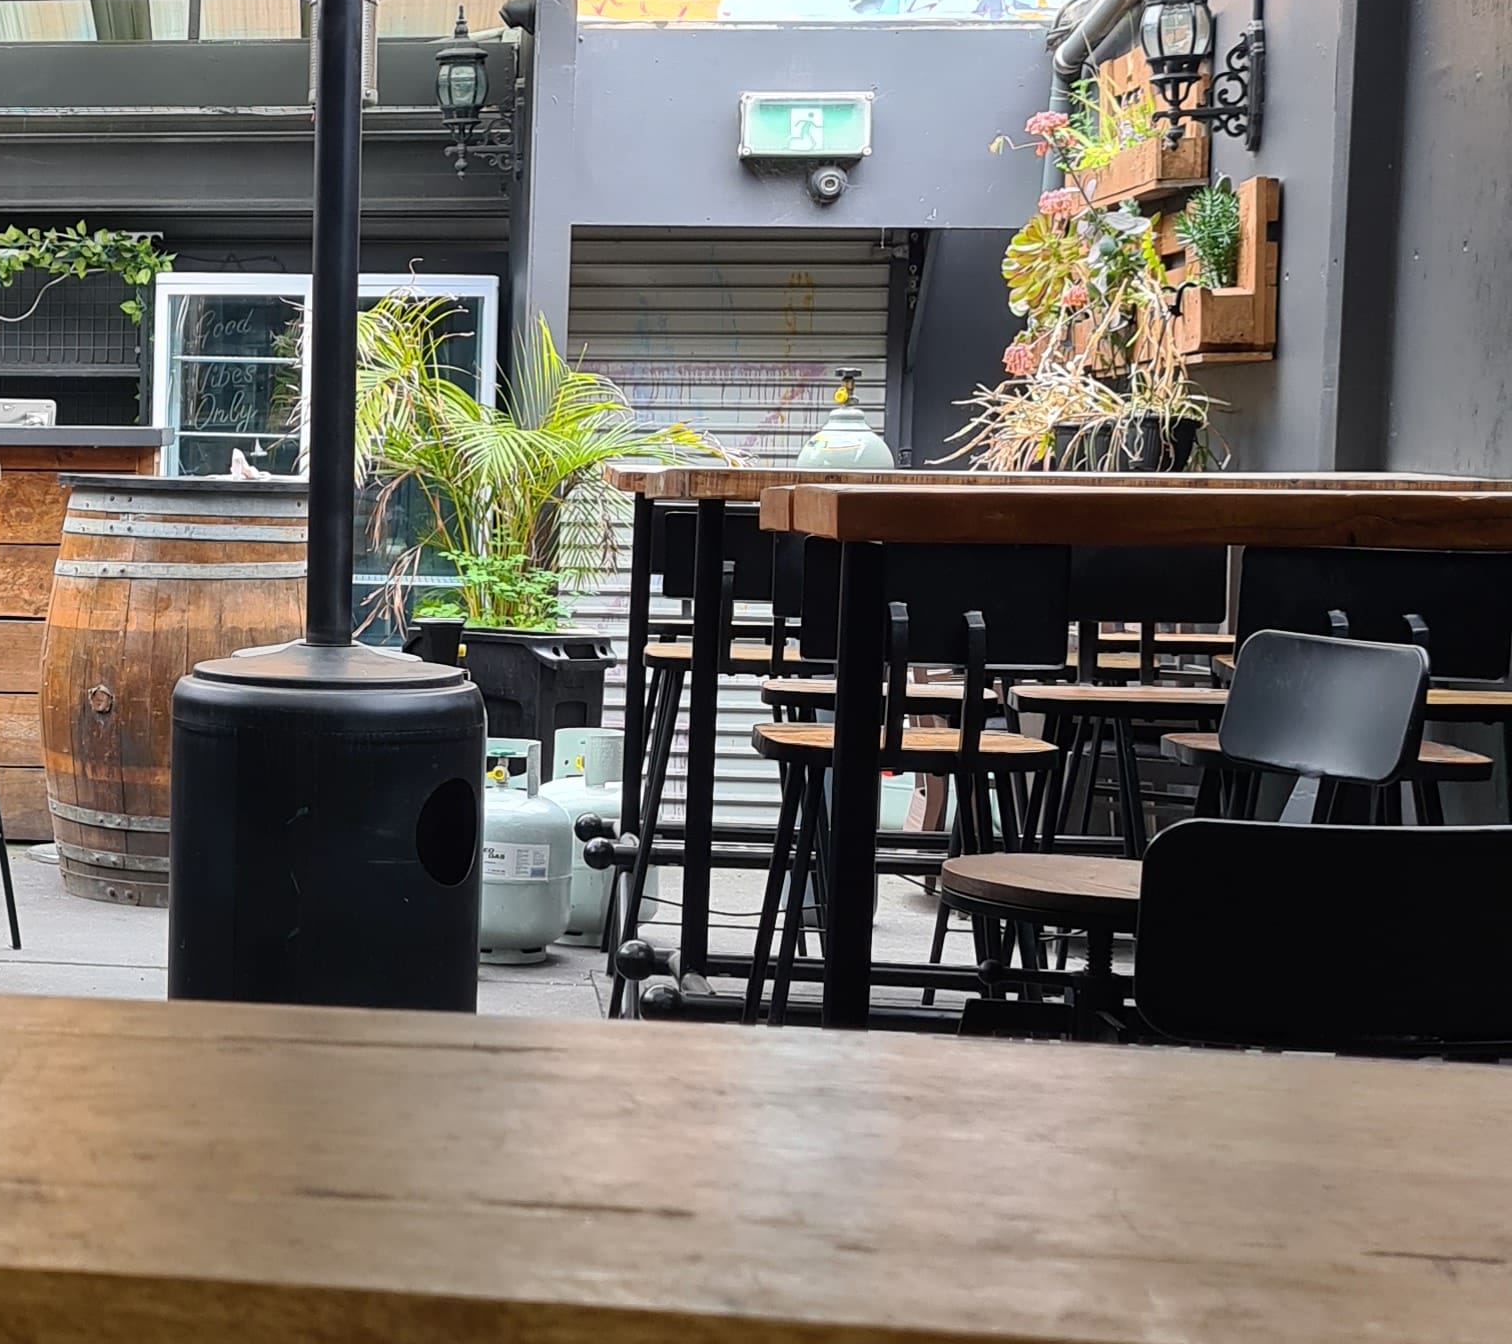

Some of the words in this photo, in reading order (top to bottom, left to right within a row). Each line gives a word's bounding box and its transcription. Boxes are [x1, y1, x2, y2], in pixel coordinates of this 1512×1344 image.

[196, 308, 255, 349] Good
[194, 362, 257, 394] Vibes
[194, 390, 259, 433] Only
